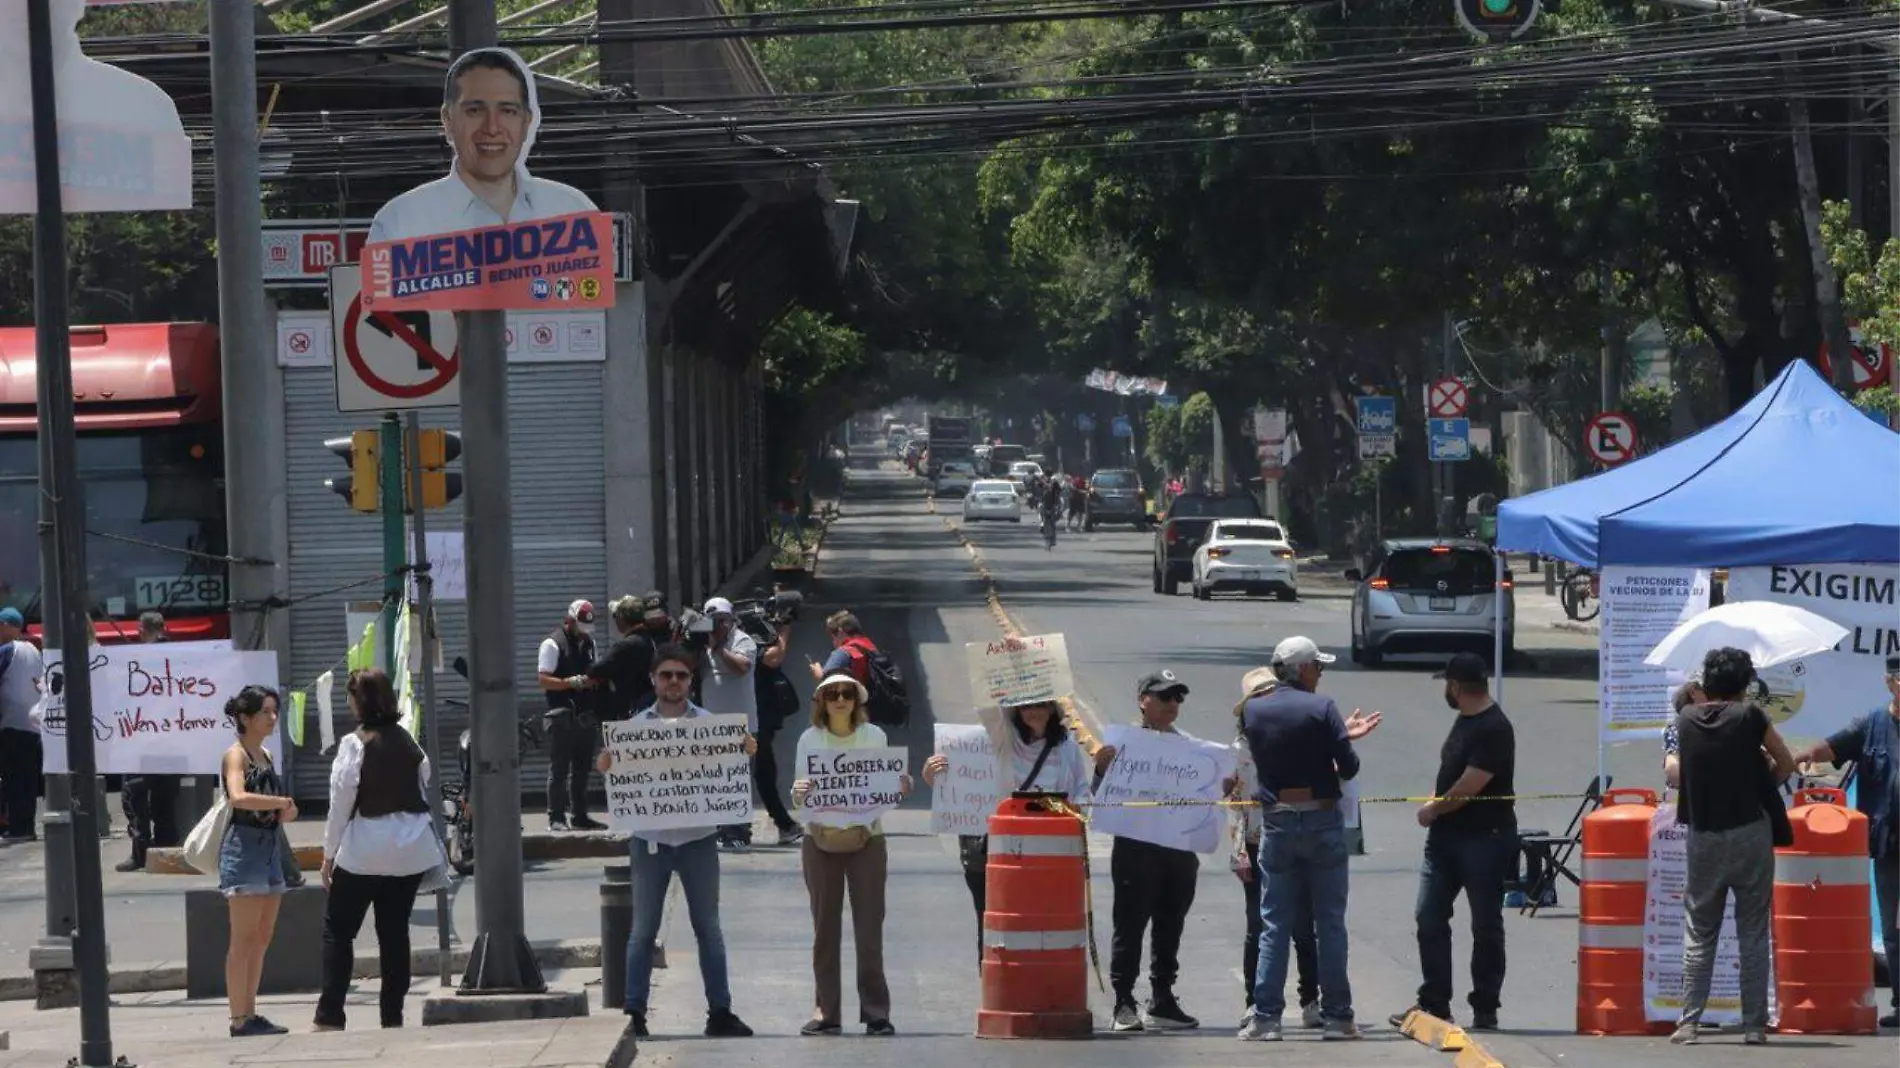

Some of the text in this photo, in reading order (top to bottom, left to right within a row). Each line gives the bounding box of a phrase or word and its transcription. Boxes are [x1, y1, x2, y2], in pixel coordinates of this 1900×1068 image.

[391, 217, 599, 279] MENDOZA
[372, 248, 391, 298] LUIS
[397, 270, 476, 295] ALCALDE
[488, 255, 600, 284] BENITO JUÁREZ
[139, 580, 222, 604] 1128
[1609, 585, 1656, 596] VECINOS
[1626, 575, 1689, 587] PETICIONES
[1769, 565, 1895, 604] EXIGIM
[127, 657, 216, 697] Batres
